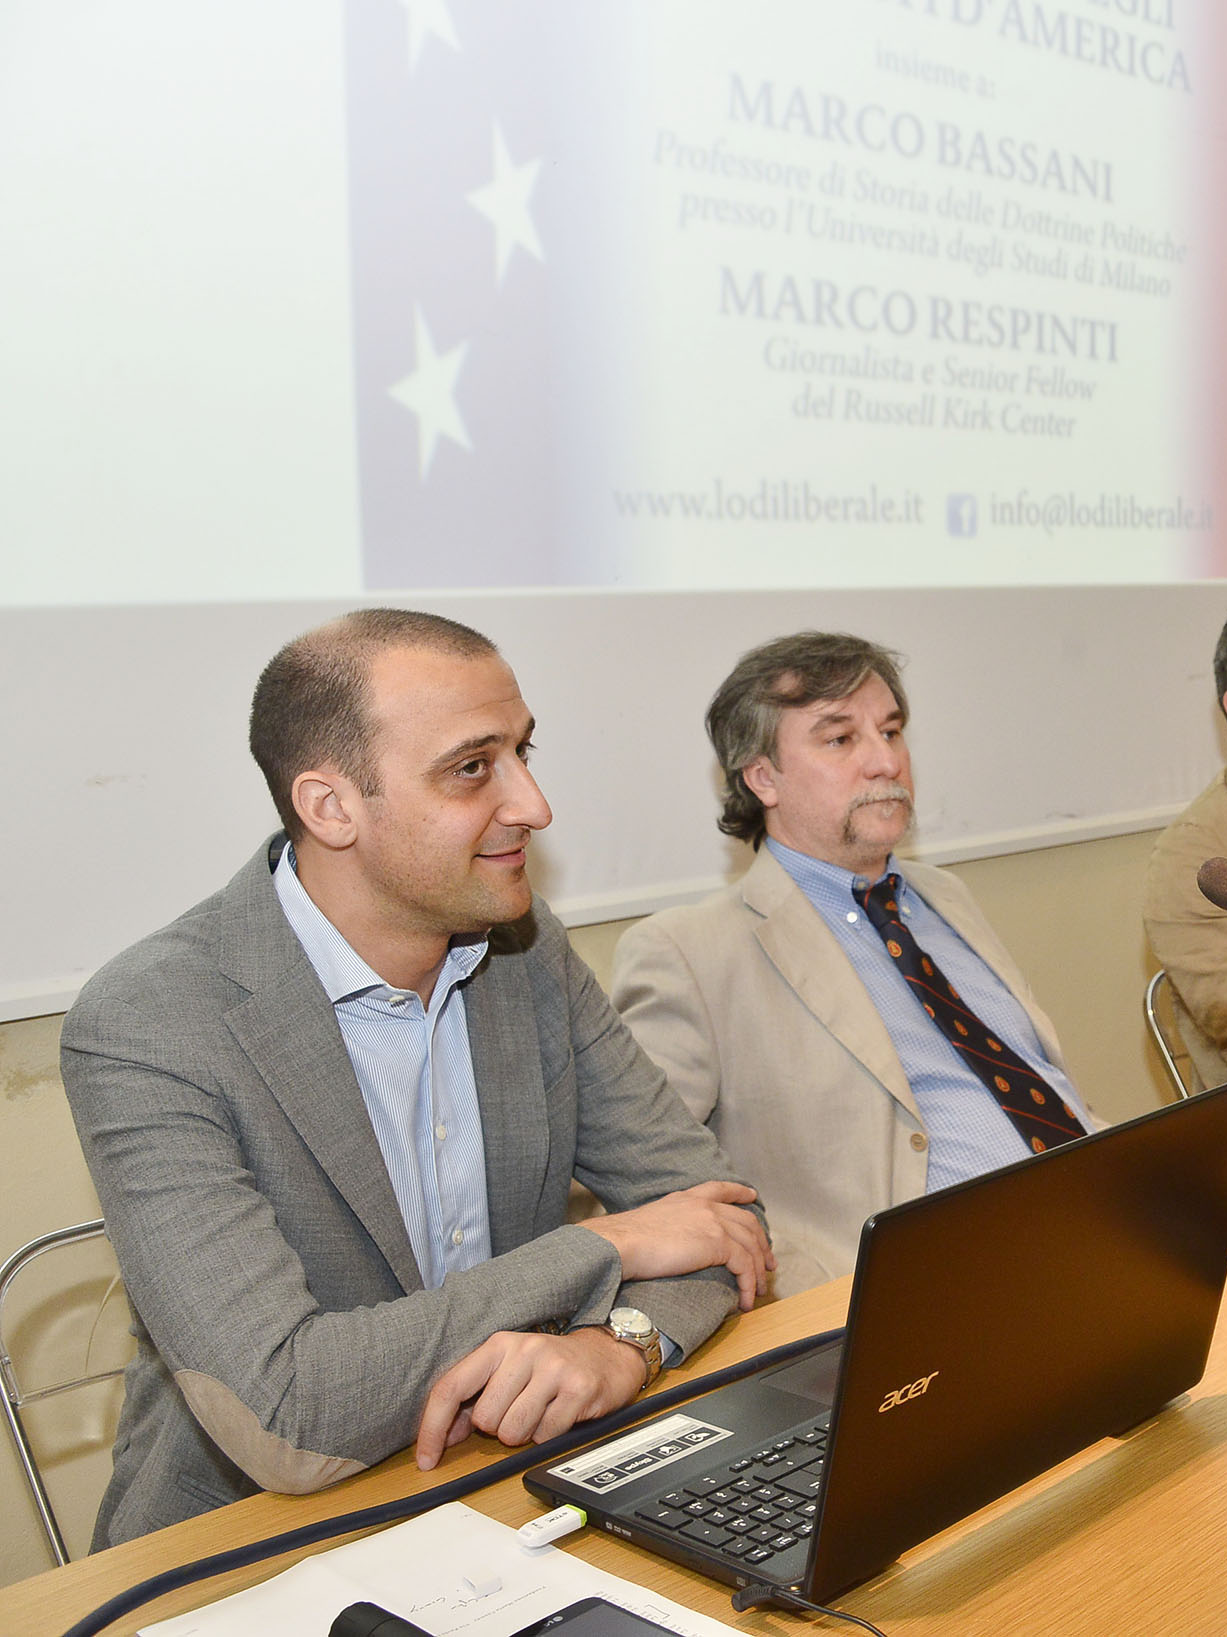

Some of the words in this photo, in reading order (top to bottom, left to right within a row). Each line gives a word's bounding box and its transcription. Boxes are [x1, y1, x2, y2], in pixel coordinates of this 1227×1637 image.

[874, 38, 971, 95] insieme
[976, 73, 997, 100] a:
[726, 71, 925, 160] MARCO
[936, 120, 1115, 204] BASSANI
[653, 128, 811, 192] Professore
[818, 160, 847, 198] di
[852, 166, 930, 215] Storia
[935, 185, 995, 227] delle
[1001, 198, 1095, 246] Dottrine
[1100, 219, 1187, 264] Politiche
[678, 191, 778, 231] presso
[946, 227, 1003, 278] degli
[1010, 240, 1068, 280] Studi
[1073, 251, 1095, 285] di
[1100, 258, 1172, 298] Milano
[717, 264, 918, 337] MARCO
[927, 294, 1120, 364] RESPINTI
[762, 335, 915, 383] Giornalista
[921, 361, 935, 386] e
[941, 355, 1019, 396] Senior
[1024, 363, 1097, 403] Fellow
[791, 381, 836, 420] del
[843, 387, 936, 428] Russell
[941, 398, 995, 432] Kirk
[1000, 403, 1077, 438] Center
[611, 476, 924, 525] www.lodiliberale.it
[989, 492, 1214, 537] info@lodiliberale.it
[879, 1371, 939, 1413] acer
